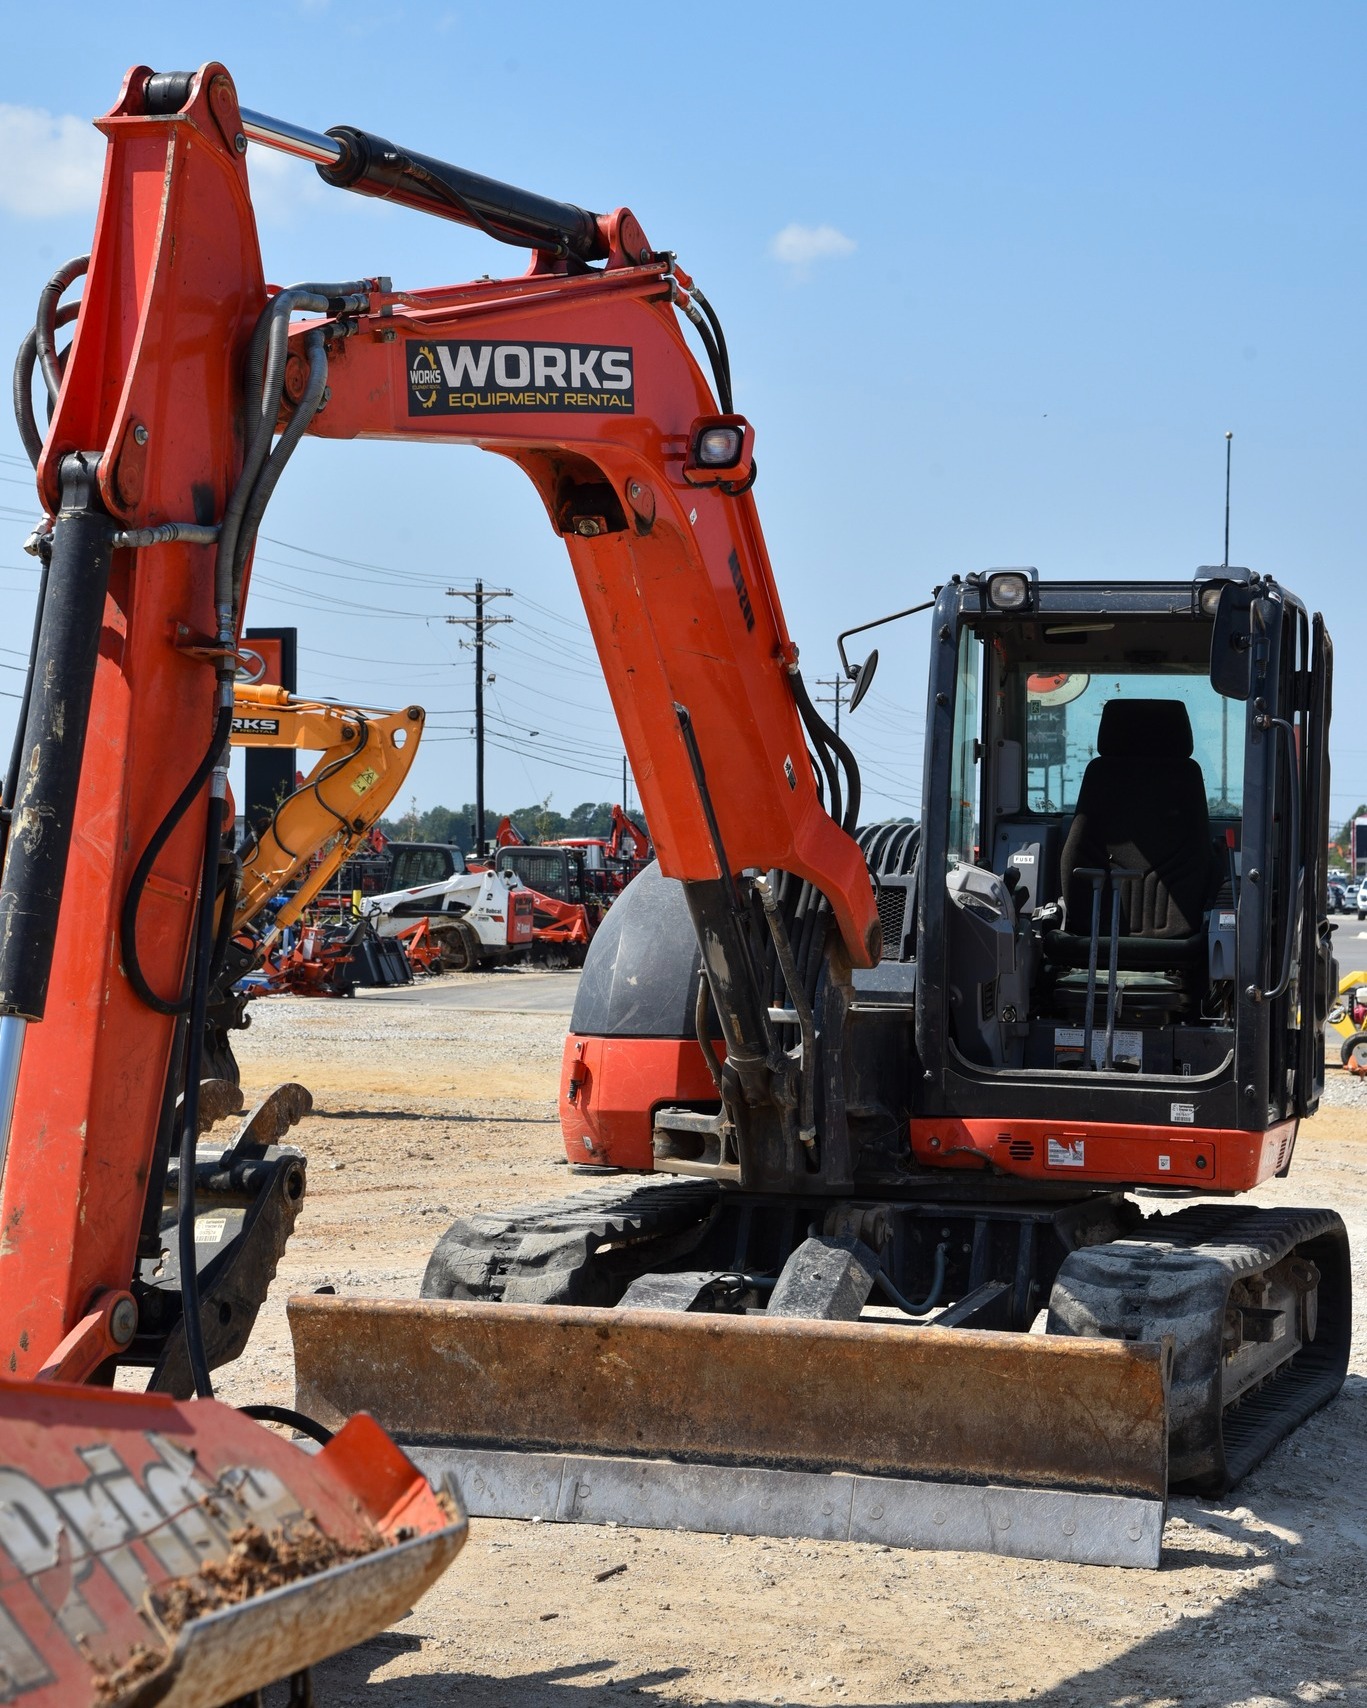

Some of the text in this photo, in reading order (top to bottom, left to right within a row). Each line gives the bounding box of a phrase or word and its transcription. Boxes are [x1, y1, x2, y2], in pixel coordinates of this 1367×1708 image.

[436, 345, 632, 390] WORKS
[410, 370, 441, 384] WORKS
[448, 393, 632, 408] EQUIPMENT RENTAL
